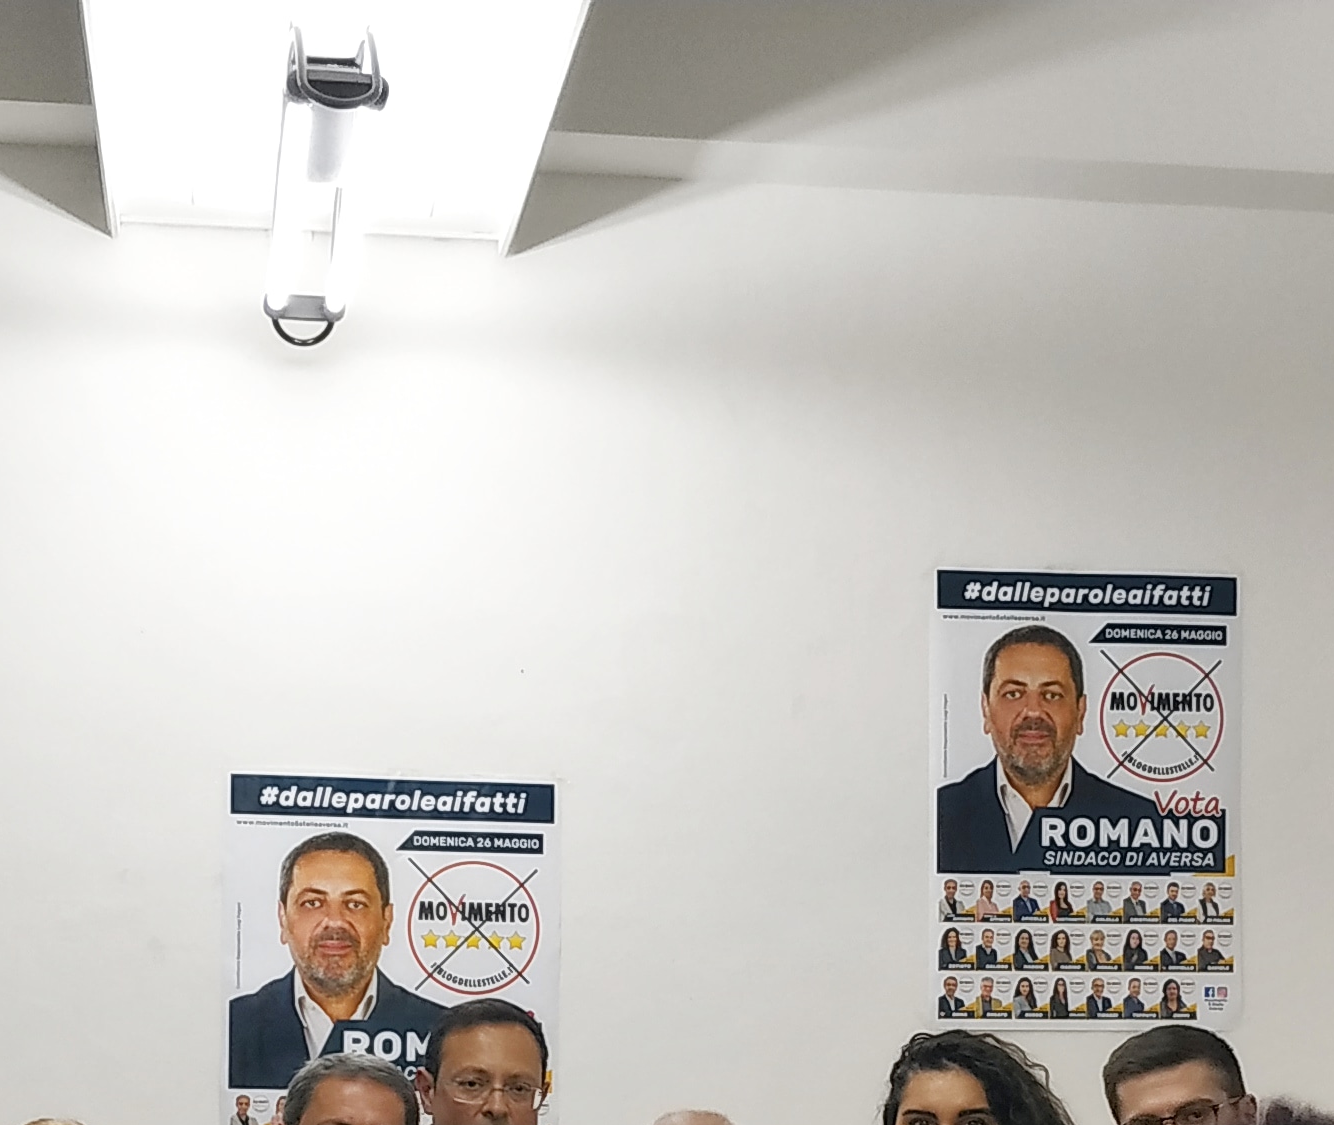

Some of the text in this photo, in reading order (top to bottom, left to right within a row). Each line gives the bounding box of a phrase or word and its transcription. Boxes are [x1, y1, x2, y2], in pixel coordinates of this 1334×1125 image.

[963, 580, 1212, 608] #dalleparoleaifatti
[1105, 628, 1223, 641] DOMENICA 26 MAGGIO
[1109, 684, 1215, 716] MOVIMENTO
[259, 785, 527, 815] #dalleparoleaifatti
[1153, 789, 1221, 816] Vota
[413, 835, 540, 850] DOMENICA 26 MAGGIO
[1040, 816, 1219, 849] ROMANO
[1043, 850, 1215, 867] SINDACO DI AVERSA
[417, 894, 530, 926] MOVIMENTO
[342, 1030, 432, 1062] ROM
